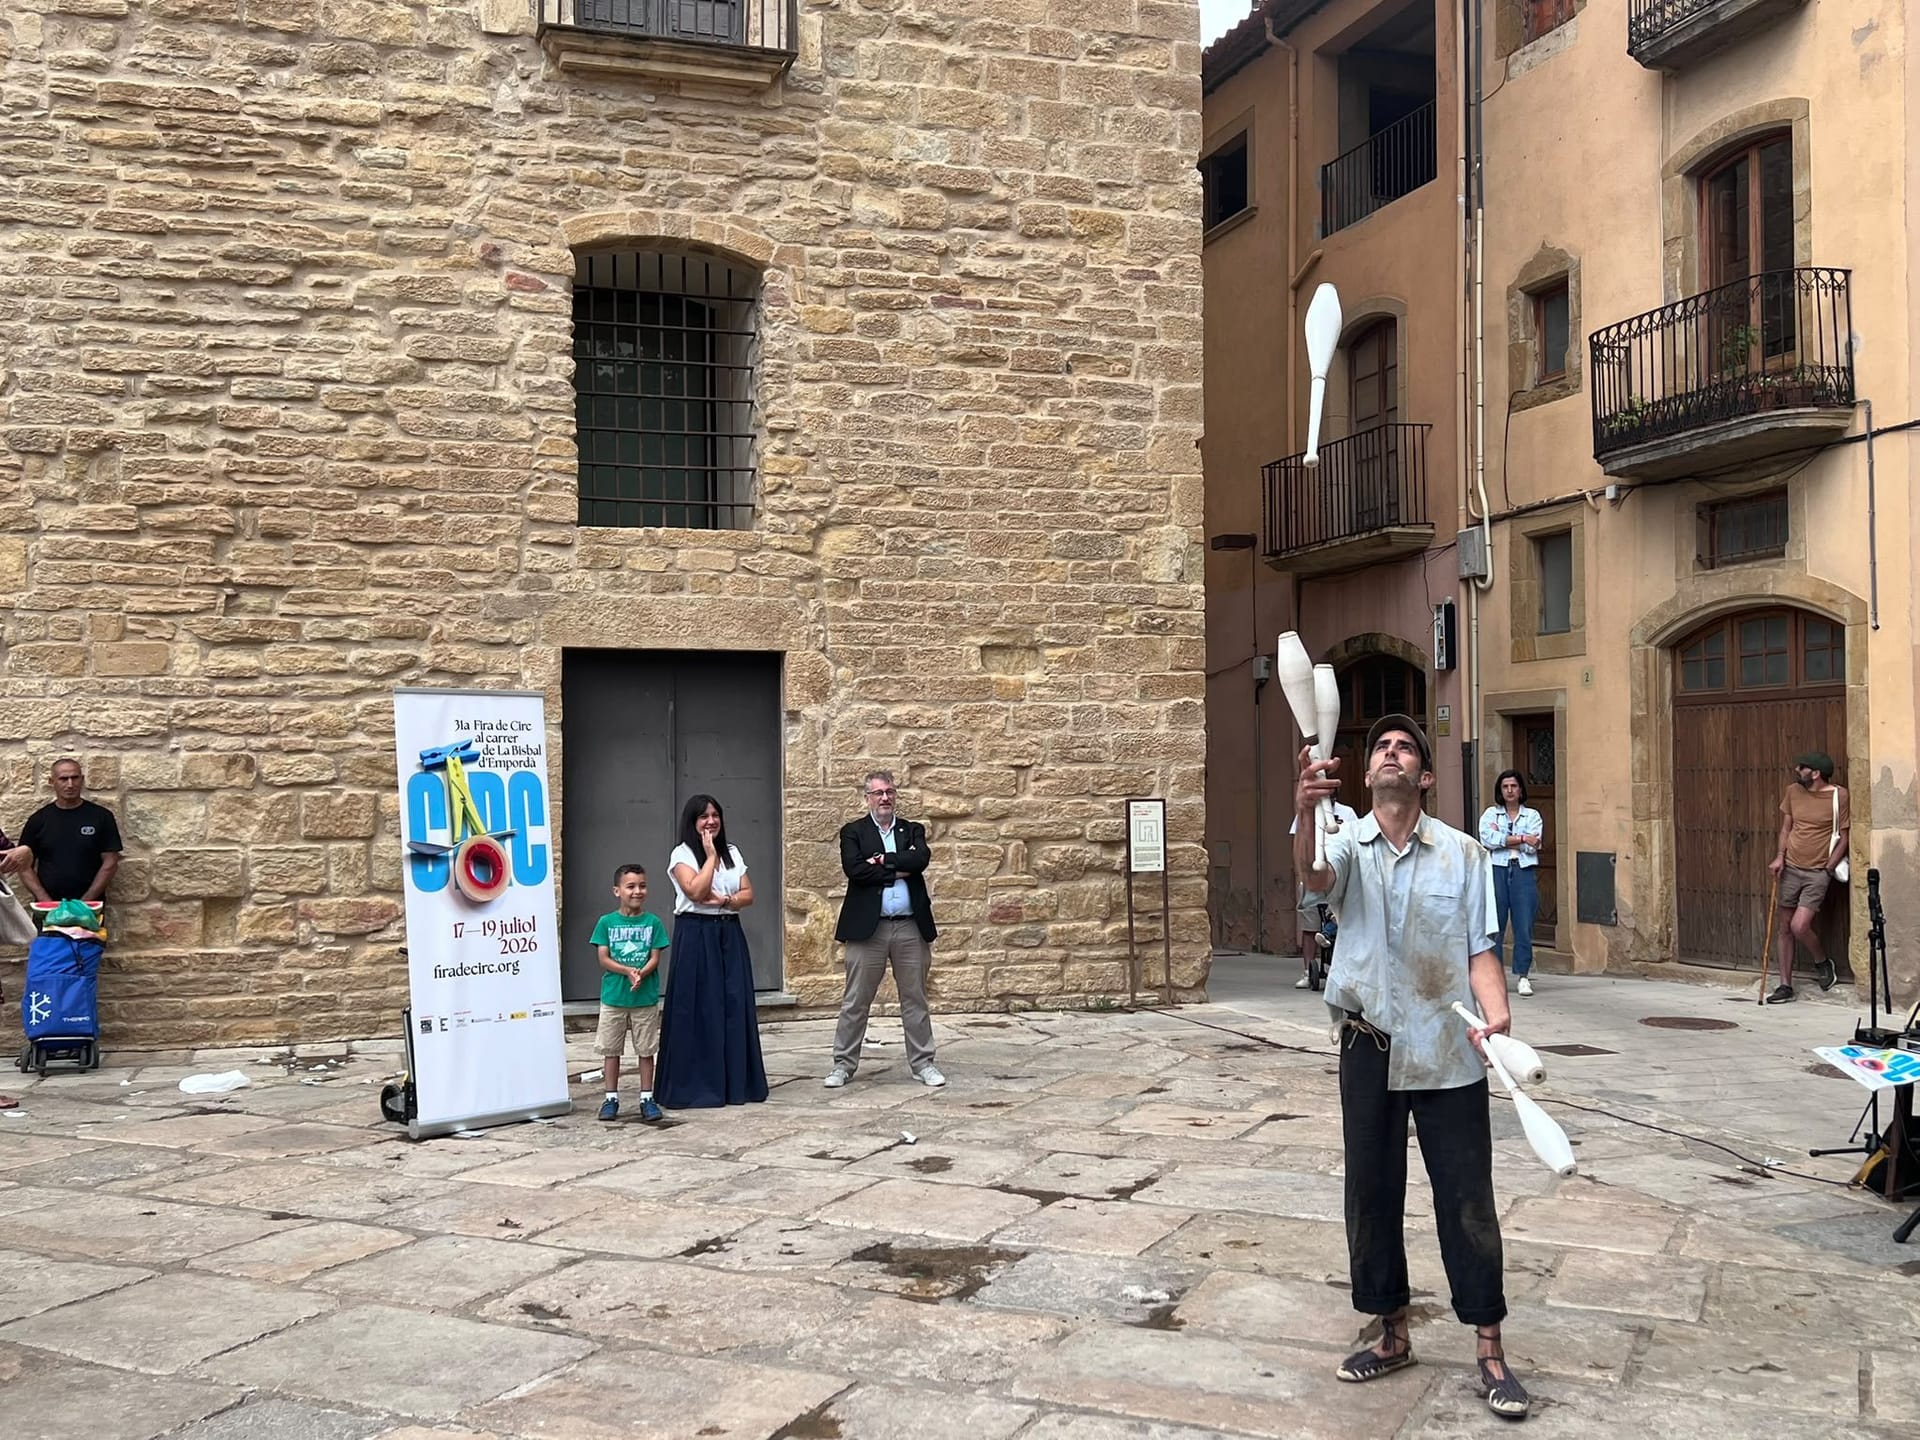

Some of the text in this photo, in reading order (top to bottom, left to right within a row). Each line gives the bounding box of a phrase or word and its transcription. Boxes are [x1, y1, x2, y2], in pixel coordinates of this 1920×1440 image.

[454, 719, 532, 732] 31a Fira de Circ
[475, 732, 518, 743] al carrer
[482, 744, 542, 756] de La Bisbal
[478, 756, 536, 771] d'Empordà
[497, 915, 536, 940] juliol
[500, 936, 538, 954] 2026
[434, 960, 520, 979] firadecirc.org
